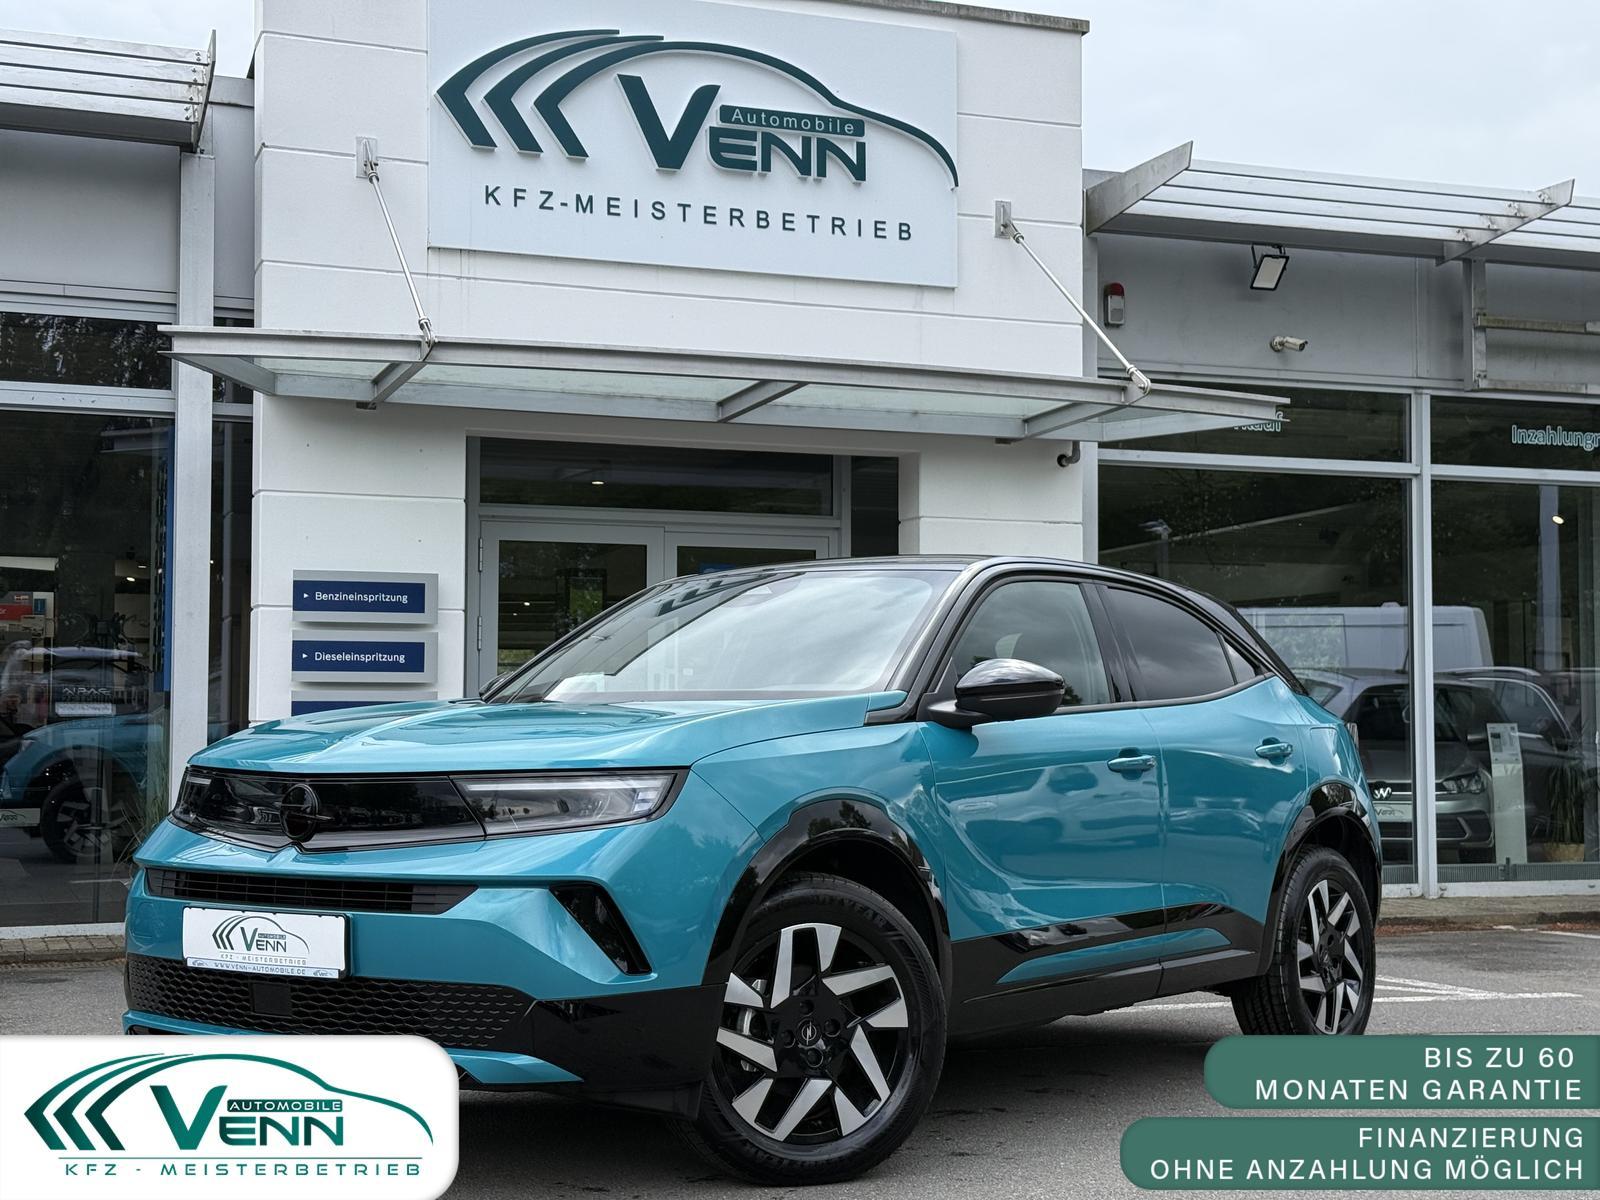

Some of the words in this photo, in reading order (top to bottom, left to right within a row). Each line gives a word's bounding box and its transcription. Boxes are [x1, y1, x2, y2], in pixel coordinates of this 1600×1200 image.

[616, 73, 867, 182] VENN
[731, 108, 856, 135] Automobile
[485, 184, 912, 241] KFZ-MEISTERBETRIEB
[315, 591, 408, 604] Benzineinspritzung
[314, 651, 406, 664] Dieseleinspritzung
[240, 926, 287, 953] VENN
